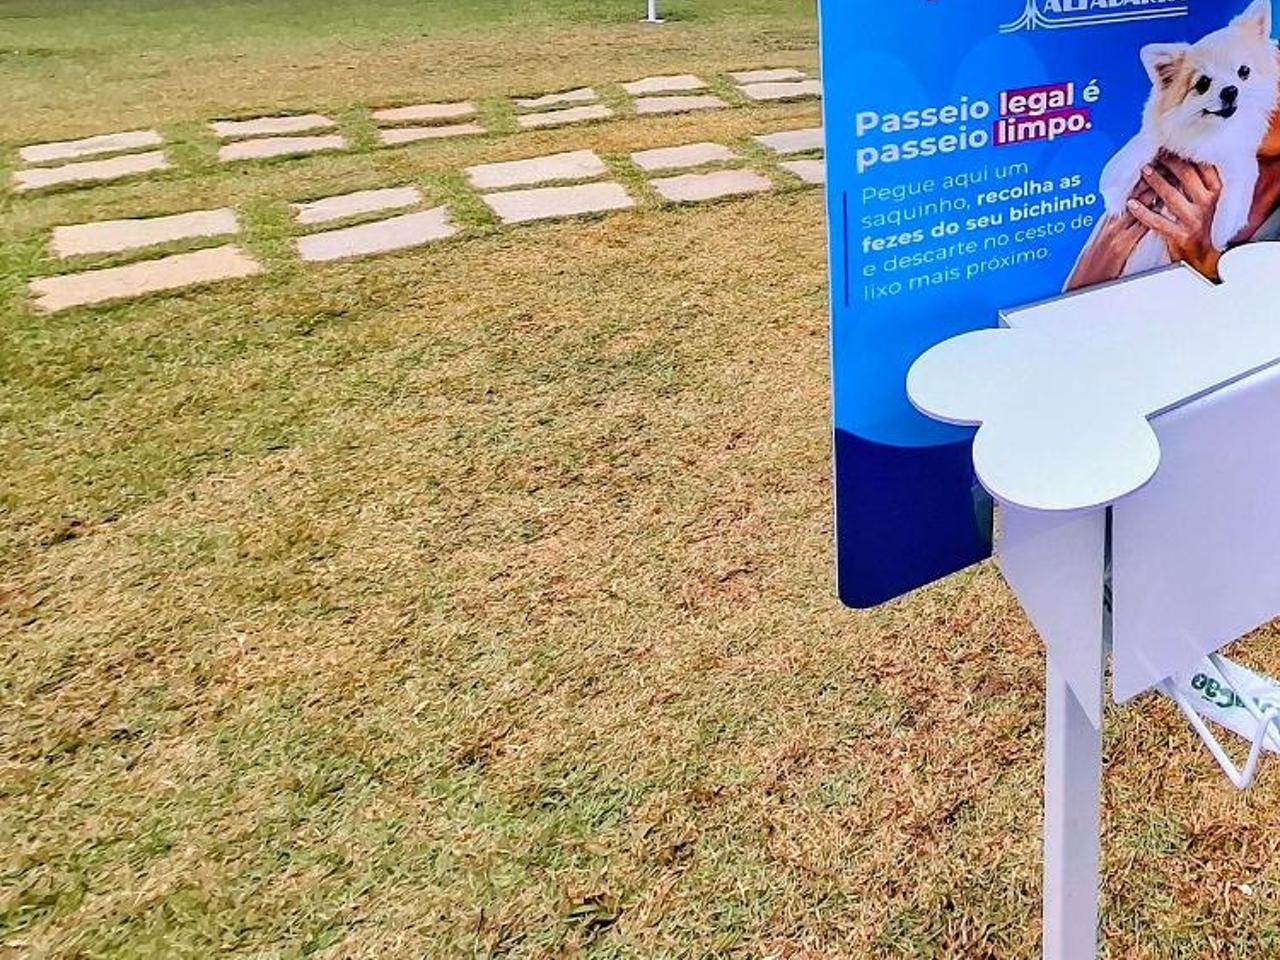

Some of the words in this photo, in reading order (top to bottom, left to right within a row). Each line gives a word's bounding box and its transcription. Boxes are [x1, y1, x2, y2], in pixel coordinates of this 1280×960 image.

[856, 95, 990, 137] Passeio
[1000, 82, 1074, 116] legal
[1083, 78, 1100, 102] é
[856, 125, 988, 174] passeio
[998, 114, 1092, 144] limpo.
[860, 194, 971, 230] saquinho,
[976, 178, 1054, 206] recolha
[1059, 173, 1081, 189] as
[862, 177, 935, 205] Pegue
[942, 165, 988, 190] aqui
[995, 160, 1028, 179] um
[861, 229, 924, 254] fezes
[931, 220, 960, 238] do
[965, 210, 1003, 230] seu
[1009, 192, 1097, 221] bichinho
[862, 264, 876, 277] e
[883, 240, 977, 273] descarte
[984, 233, 1009, 250] no
[1014, 220, 1066, 243] cesto
[1071, 212, 1093, 230] de
[863, 280, 902, 301] lixo
[909, 266, 960, 289] mais
